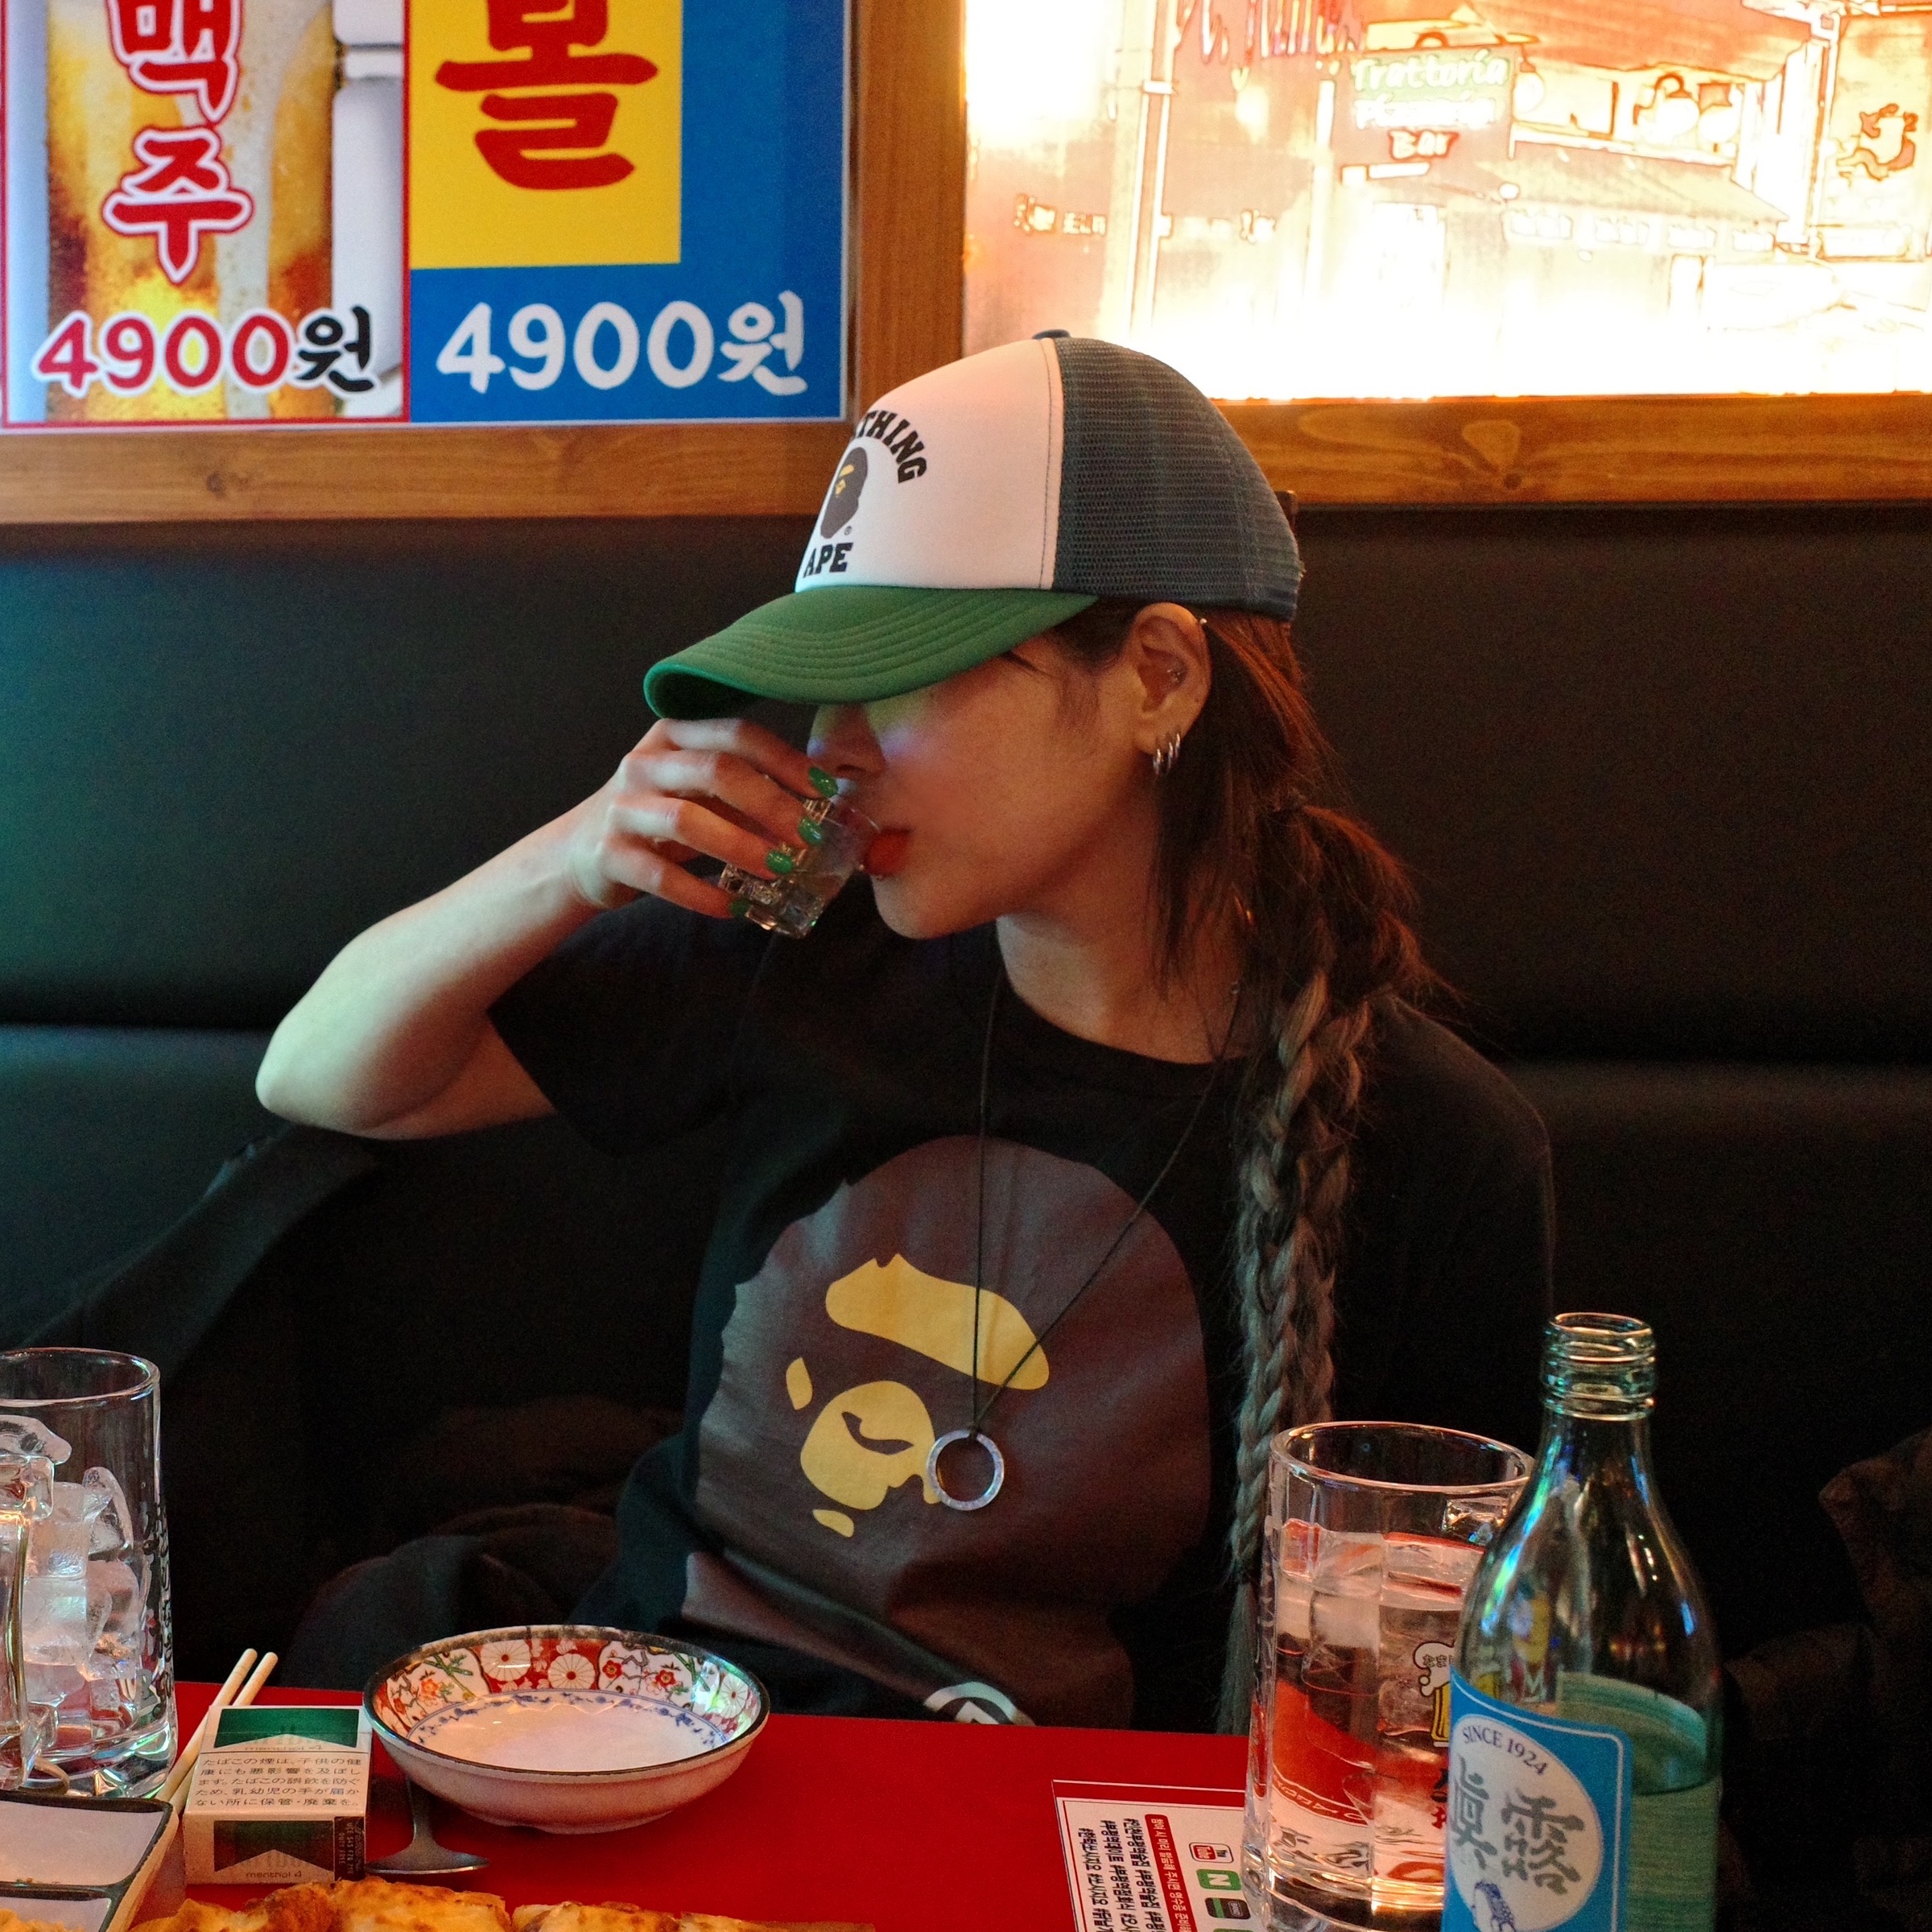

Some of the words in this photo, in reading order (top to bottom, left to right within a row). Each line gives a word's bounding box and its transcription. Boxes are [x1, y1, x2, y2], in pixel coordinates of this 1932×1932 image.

[32, 304, 380, 398] 4900원
[436, 291, 808, 397] 4900원
[802, 542, 853, 579] APE
[1462, 1725, 1503, 1749] SINCE
[1507, 1738, 1549, 1776] 1924
[1151, 1818, 1166, 1830] 참여
[1157, 1839, 1171, 1851] 미리
[1159, 1852, 1176, 1870] 말씀해
[1134, 1870, 1161, 1909] #부평역술집
[1165, 1872, 1181, 1890] 주시면
[1207, 1874, 1231, 1887] N
[1170, 1893, 1186, 1911] 영수증
[1145, 1911, 1166, 1932] #부평
